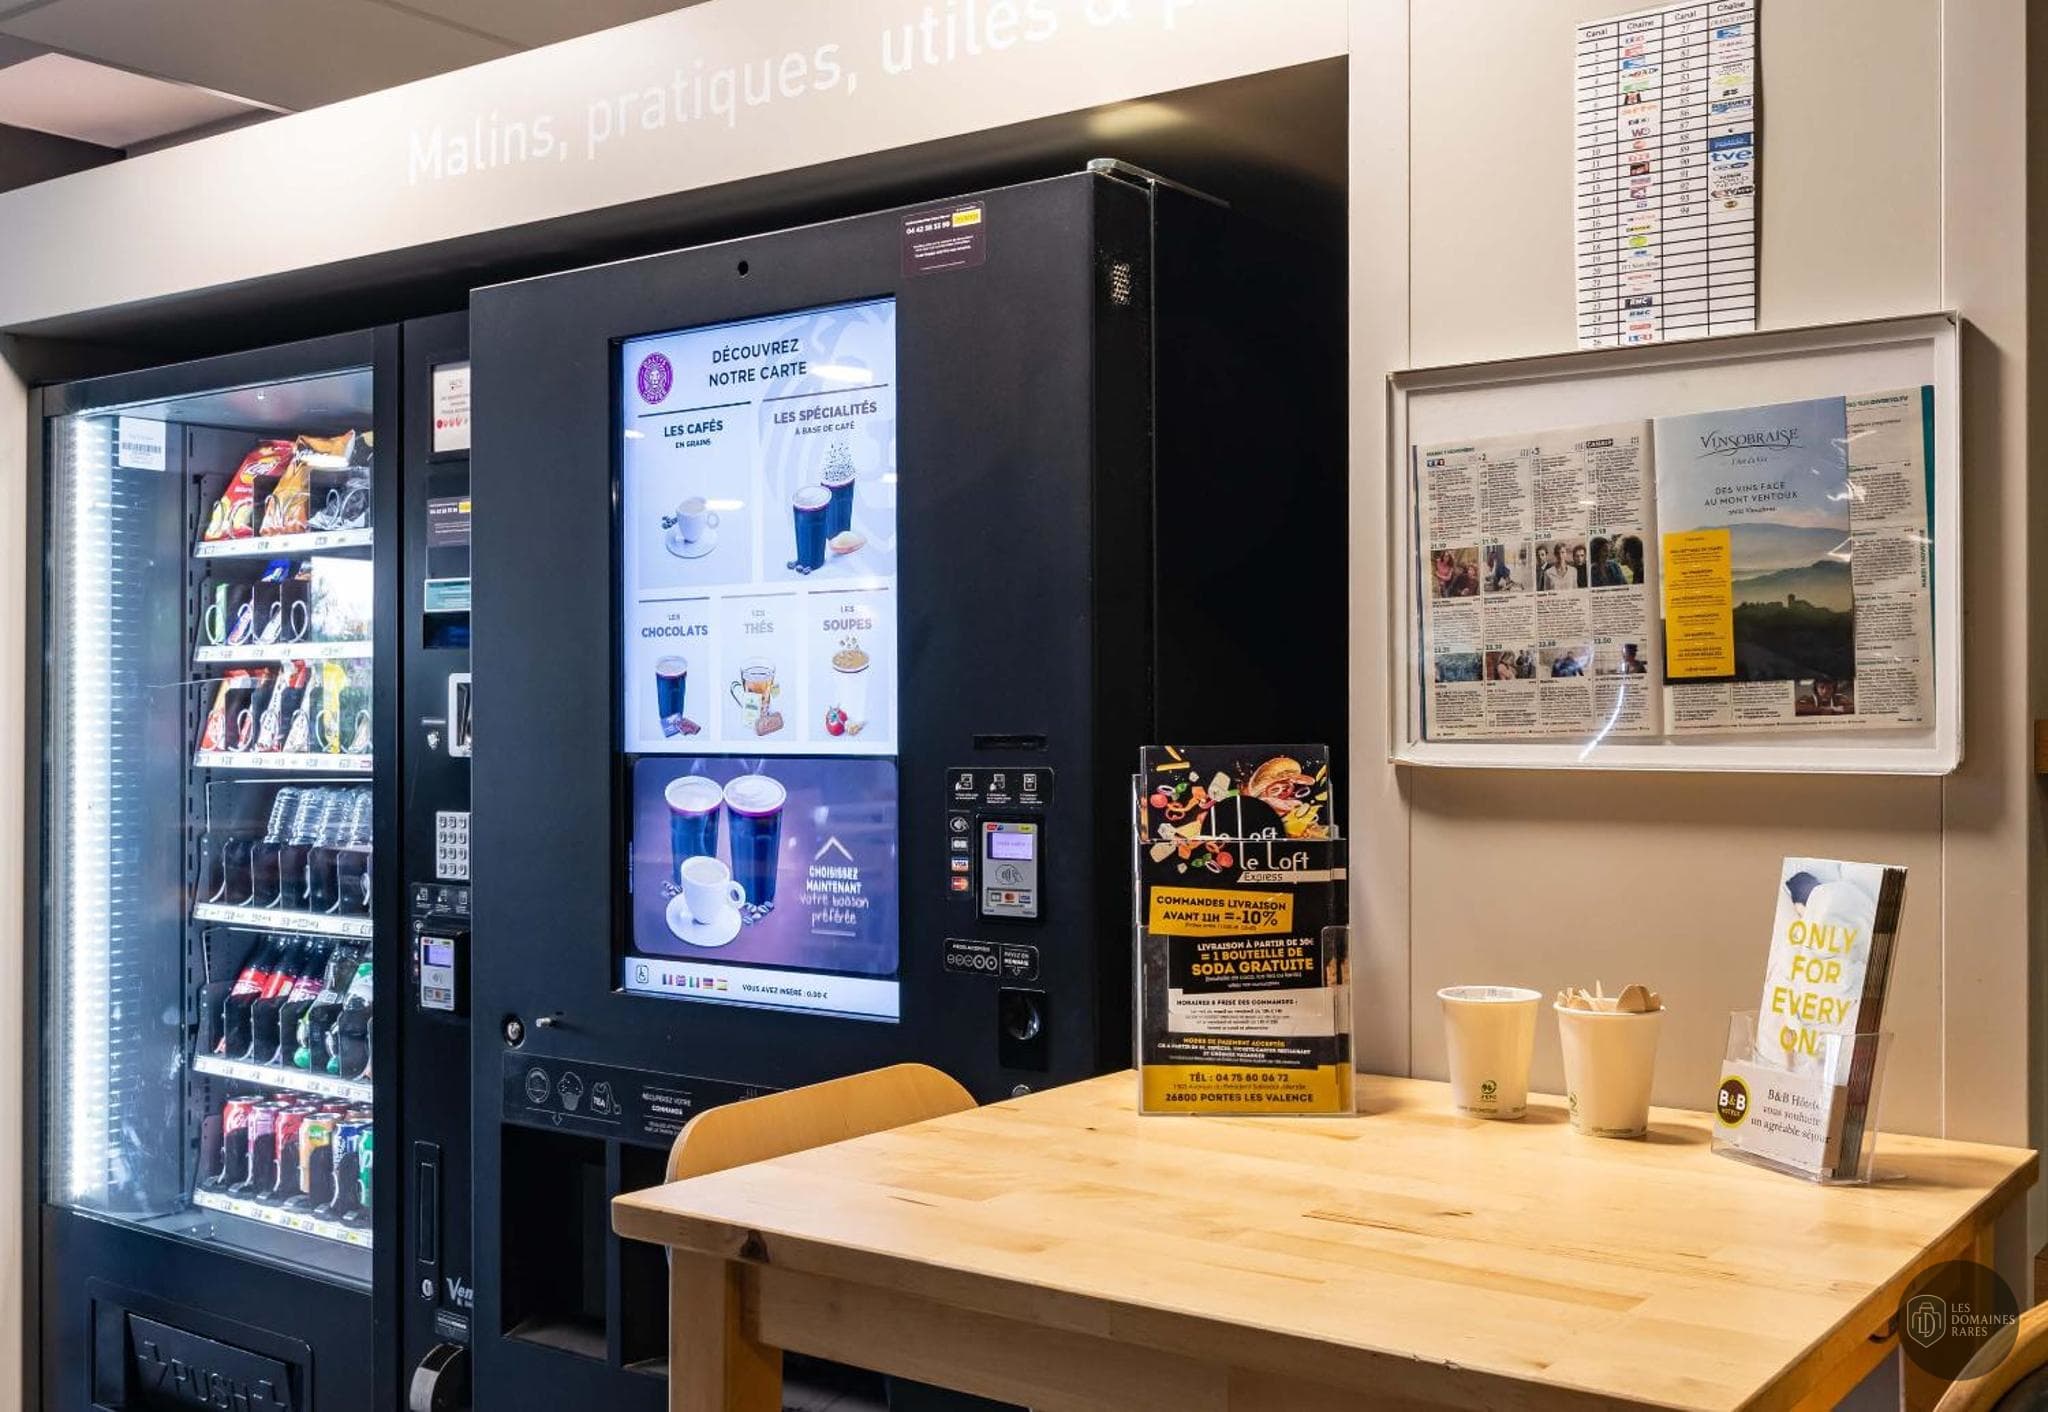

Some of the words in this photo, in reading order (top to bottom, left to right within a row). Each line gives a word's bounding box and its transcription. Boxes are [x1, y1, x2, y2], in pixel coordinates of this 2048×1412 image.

[1586, 28, 1608, 38] Canal
[1674, 10, 1696, 20] Canal
[407, 111, 567, 187] Malins,
[587, 41, 858, 161] pratiques,
[884, 0, 1059, 76] utiles
[1711, 150, 1752, 162] tve
[712, 338, 800, 364] DÉCOUVREZ
[709, 370, 756, 387] NOTRE
[760, 362, 808, 382] CARTE
[774, 412, 796, 424] LES
[799, 400, 877, 422] SPÉCIALITÉS
[664, 424, 685, 438] LES
[688, 419, 724, 434] CAFÉS
[802, 426, 822, 436] BASE
[823, 424, 832, 433] DE
[1715, 486, 1734, 496] DES
[1736, 484, 1758, 492] VINS
[1761, 481, 1786, 490] FACE
[1704, 498, 1717, 506] AU
[641, 624, 708, 638] CHOCOLATS
[744, 619, 774, 634] THÉS
[823, 618, 872, 632] SOUPES
[1240, 841, 1259, 870] le
[1267, 841, 1310, 873] Loft
[809, 865, 858, 880] CHOISISSEZ
[1244, 872, 1283, 882] Express
[806, 878, 862, 894] MAINTENANT
[1156, 896, 1225, 908] COMMANDES
[1228, 898, 1286, 911] LIVRAISON
[1163, 911, 1200, 922] AVANT
[1202, 912, 1220, 922] 11H
[1197, 942, 1244, 952] LIVRAISON
[1254, 939, 1284, 948] PARTIR
[1788, 920, 1858, 956] ONLY
[1213, 952, 1219, 960] 1
[1222, 948, 1284, 960] BOUTEILLE
[1288, 948, 1304, 958] DE
[1192, 962, 1236, 976] SODA
[1240, 958, 1314, 974] GRATUITE
[1790, 955, 1842, 985] FOR
[742, 984, 760, 992] VOUS
[1772, 986, 1851, 1026] EVERY
[1779, 1026, 1822, 1058] ON
[1190, 1072, 1206, 1082] TÉL
[594, 1096, 606, 1107] TEA
[1166, 1093, 1197, 1102] 26800
[1200, 1093, 1241, 1102] PORTES
[1244, 1093, 1263, 1102] LES
[1266, 1093, 1314, 1102] VALENCE
[1719, 1089, 1746, 1111] B&B
[1768, 1089, 1790, 1104] B&B
[1751, 1118, 1762, 1127] un
[1764, 1120, 1801, 1137] agréable
